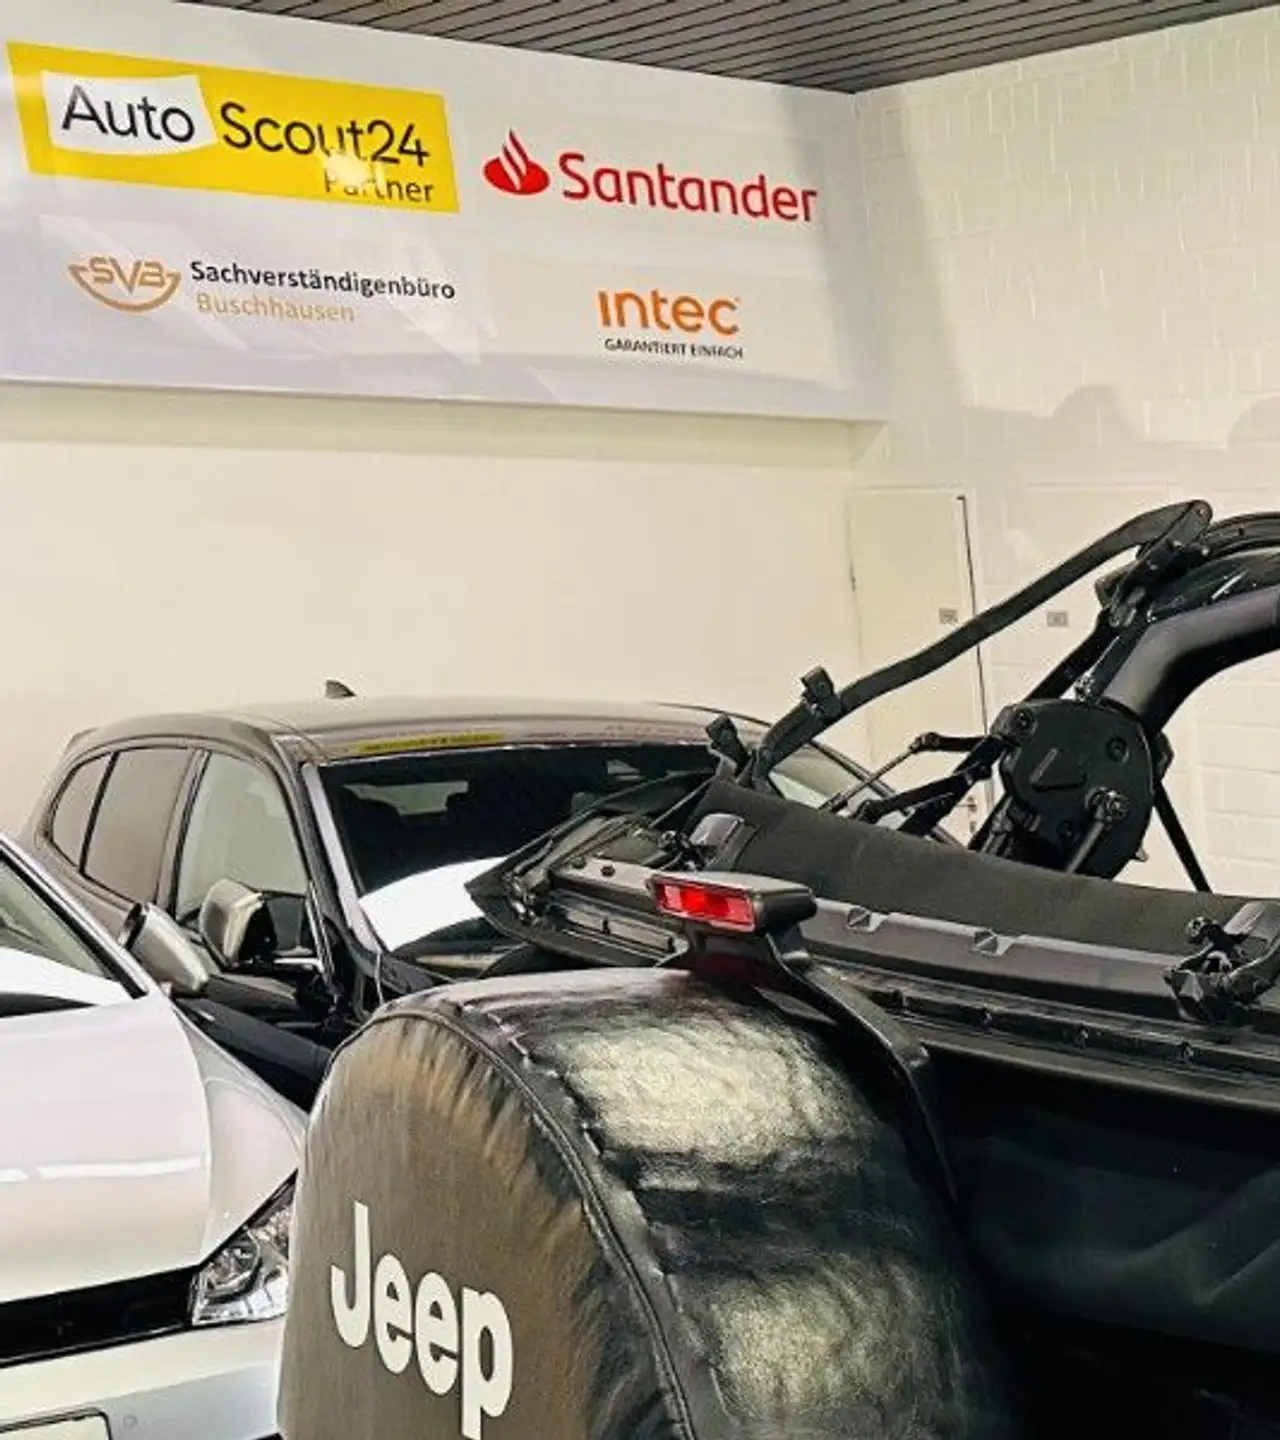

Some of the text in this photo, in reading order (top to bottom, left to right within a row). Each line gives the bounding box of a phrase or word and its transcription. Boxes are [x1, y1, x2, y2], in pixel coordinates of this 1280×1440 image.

[61, 84, 431, 166] Auto Scout24
[323, 167, 434, 203] Ptner
[557, 152, 819, 222] Santander
[88, 256, 166, 294] SVB
[189, 260, 457, 300] Sachverständigenbüro
[197, 292, 356, 324] Buschhausen
